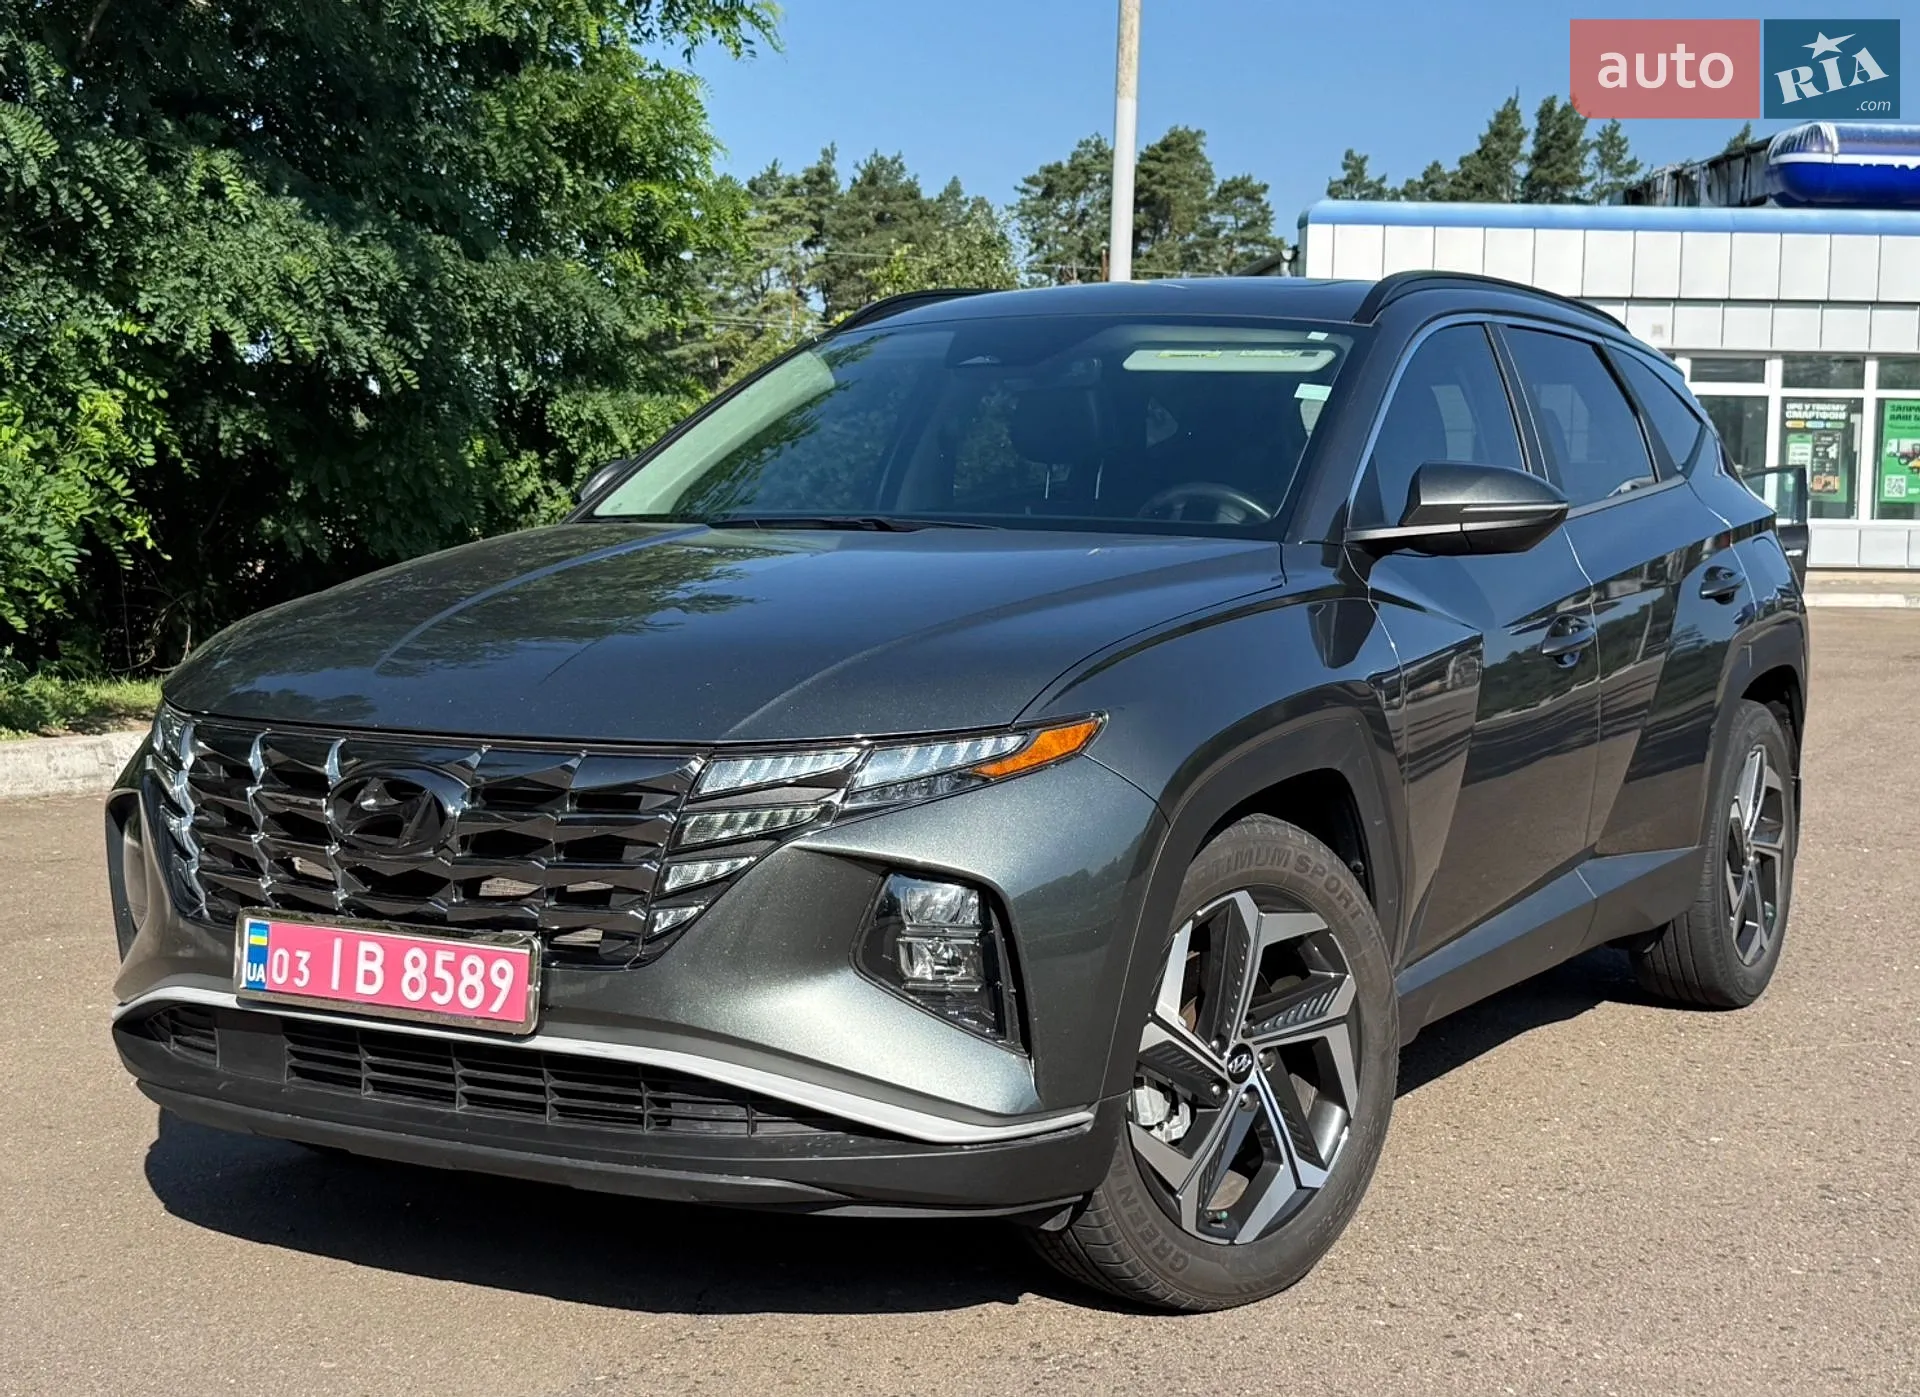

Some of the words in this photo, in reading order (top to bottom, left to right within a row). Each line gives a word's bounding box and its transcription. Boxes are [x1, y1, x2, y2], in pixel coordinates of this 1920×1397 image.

[1294, 853, 1366, 919] SPORT
[247, 962, 266, 983] UA
[271, 947, 311, 988] 03
[400, 946, 514, 1013] 8589
